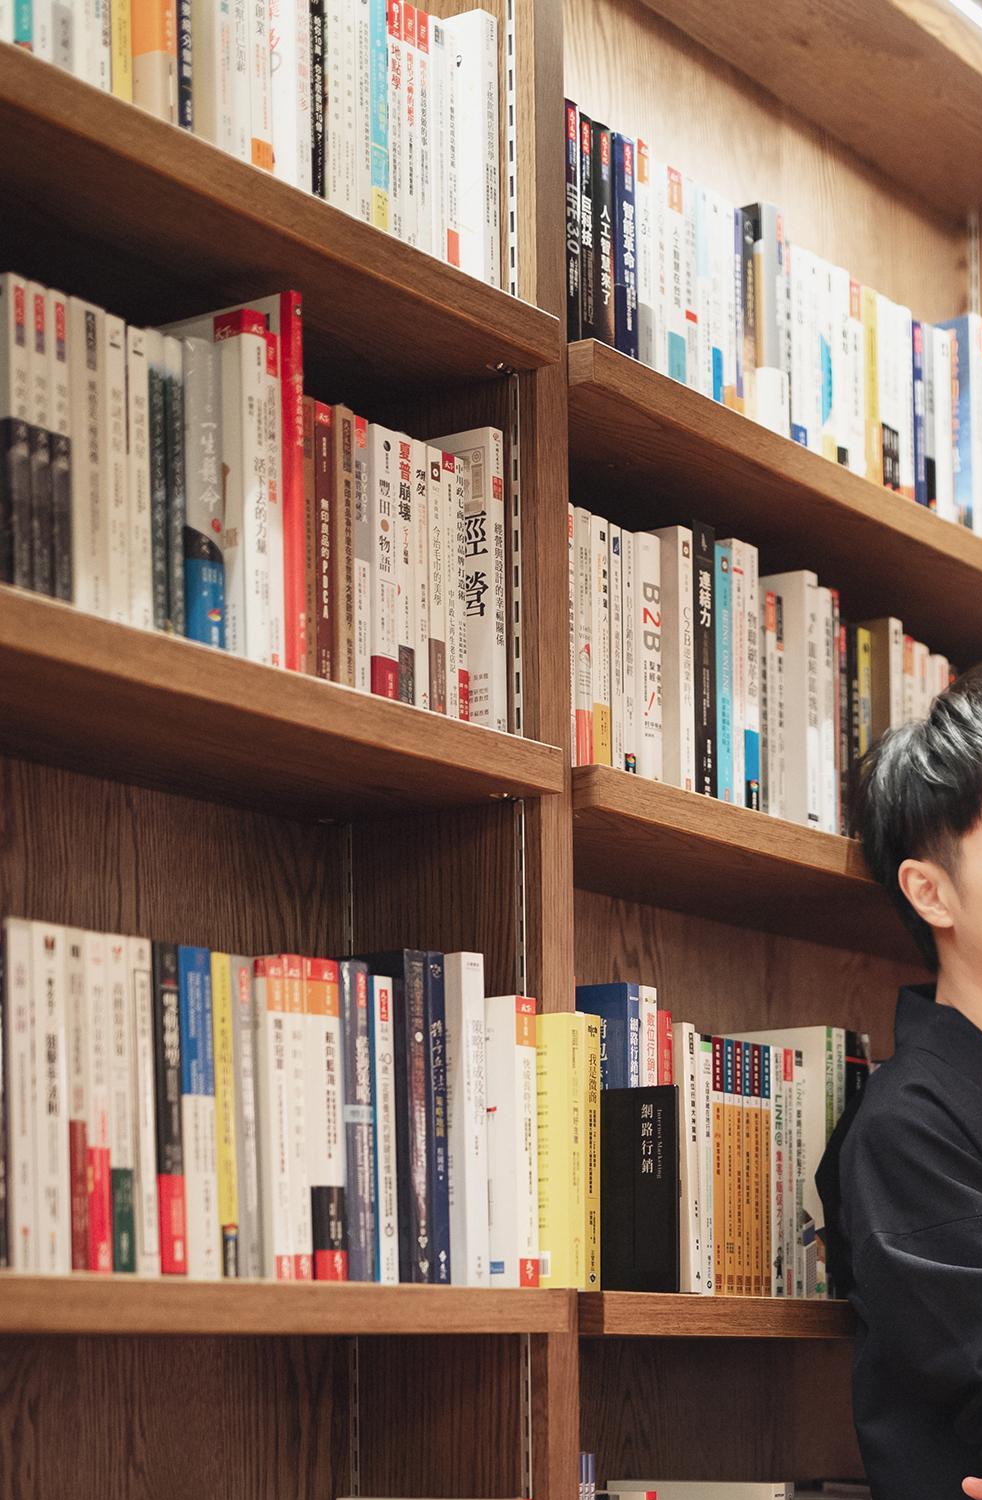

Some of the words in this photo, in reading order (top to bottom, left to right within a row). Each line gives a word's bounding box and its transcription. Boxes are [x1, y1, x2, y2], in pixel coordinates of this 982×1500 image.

[567, 182, 579, 223] LIFE
[643, 581, 661, 654] B2B
[640, 1103, 653, 1174] 網路行銷
